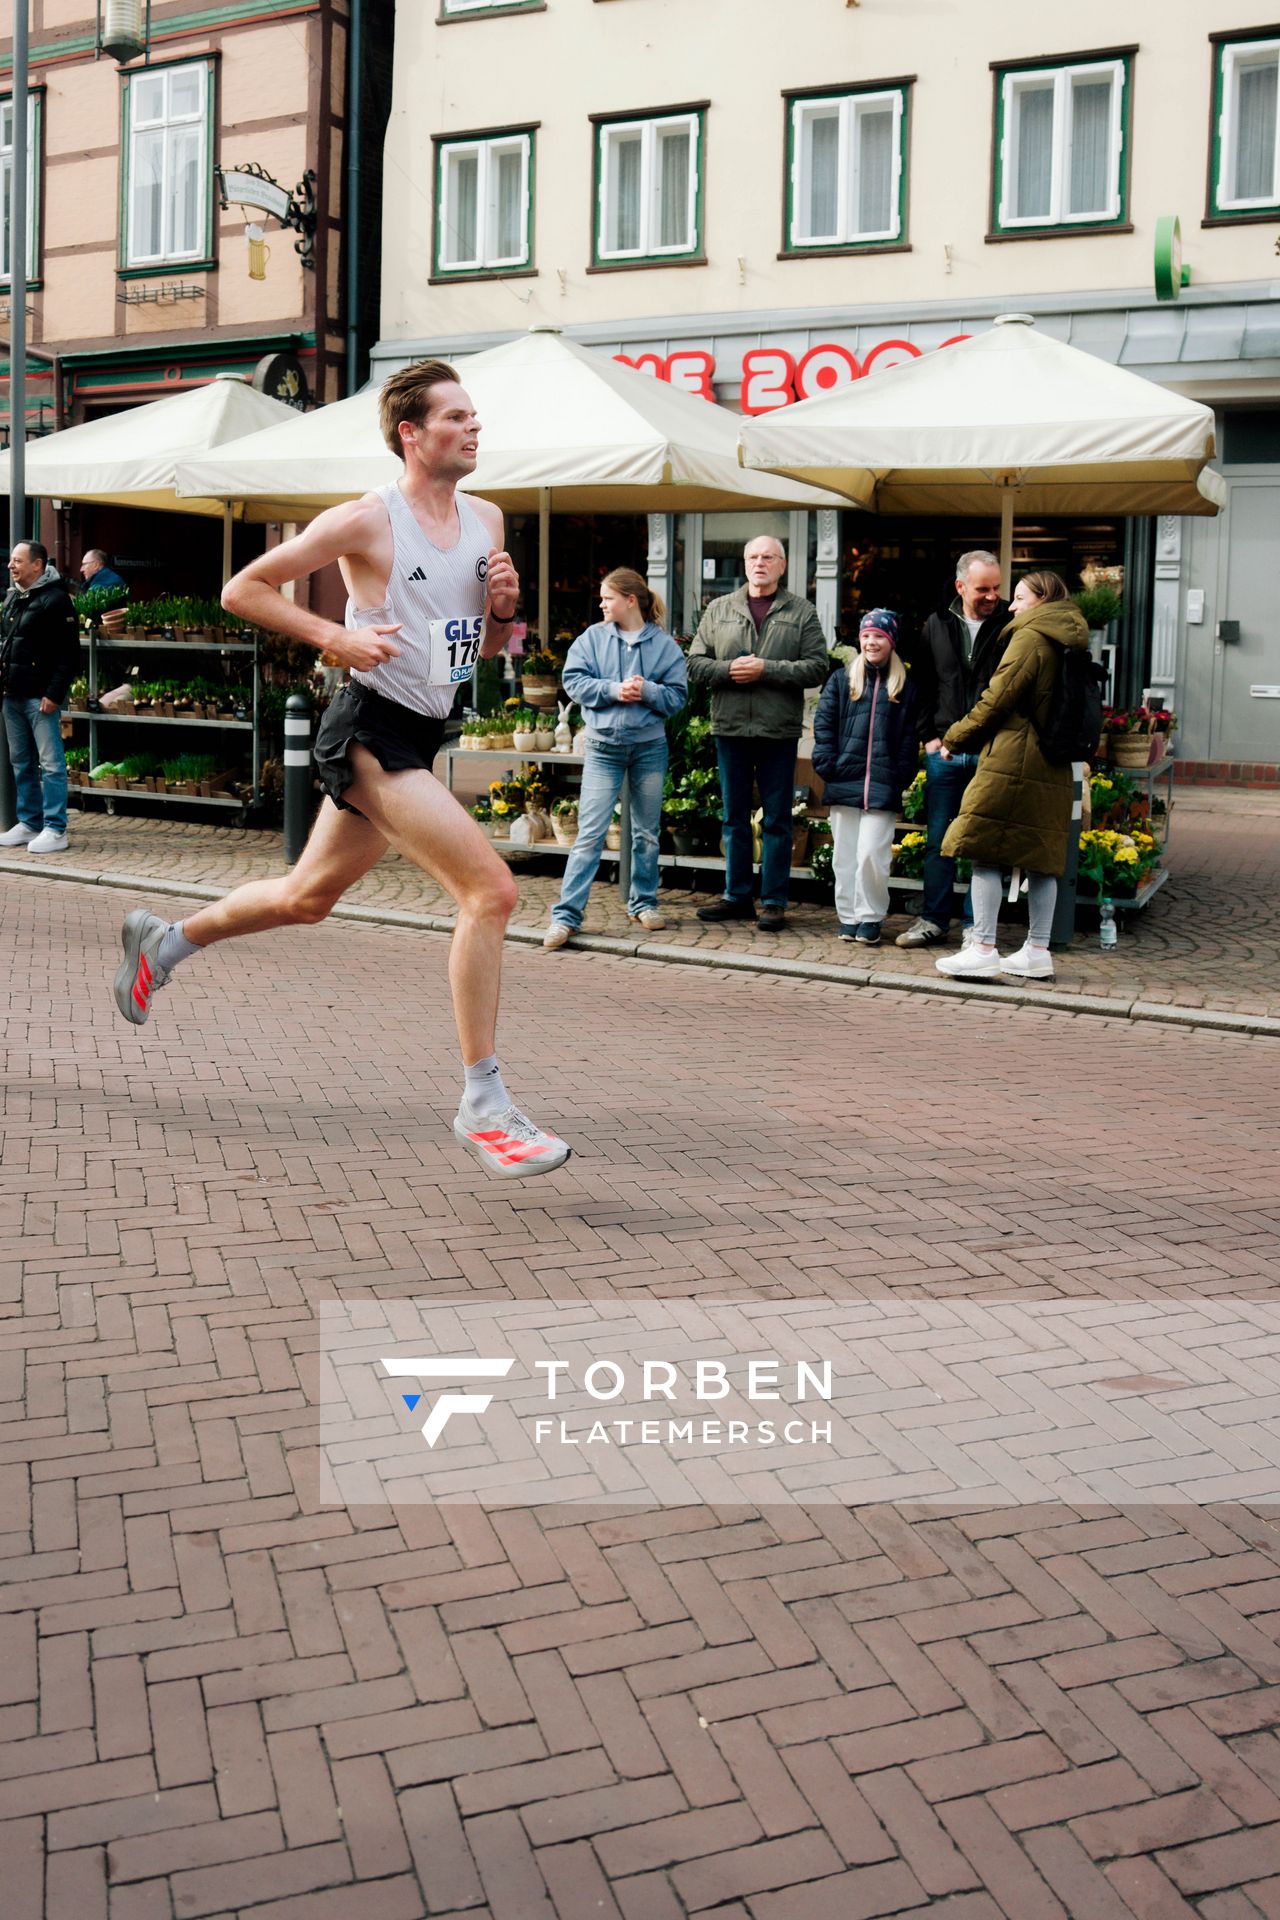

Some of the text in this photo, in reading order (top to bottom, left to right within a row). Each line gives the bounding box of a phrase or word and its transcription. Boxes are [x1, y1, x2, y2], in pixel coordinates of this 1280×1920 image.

[741, 334, 974, 417] 20
[445, 617, 483, 641] GLS
[447, 638, 480, 668] 178
